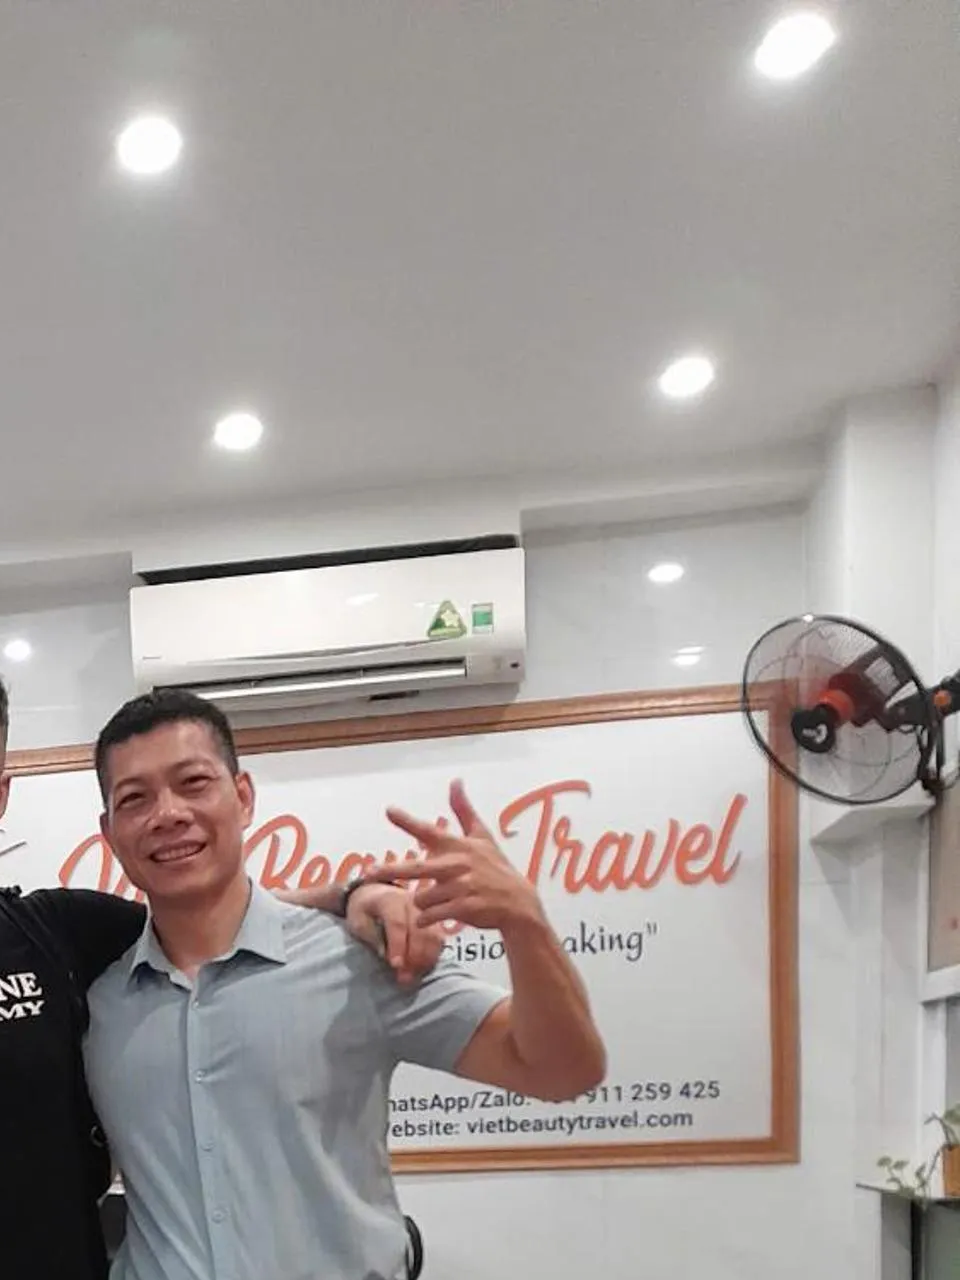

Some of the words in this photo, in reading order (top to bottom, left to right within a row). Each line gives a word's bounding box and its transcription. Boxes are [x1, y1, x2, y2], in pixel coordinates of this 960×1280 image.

[499, 779, 748, 894] Travel
[440, 934, 505, 962] cisio
[563, 921, 658, 962] aking"
[631, 1082, 672, 1101] 259
[679, 1080, 721, 1099] 425
[388, 1119, 461, 1138] ebsite:
[467, 1109, 694, 1137] vietbeautytravel.com
